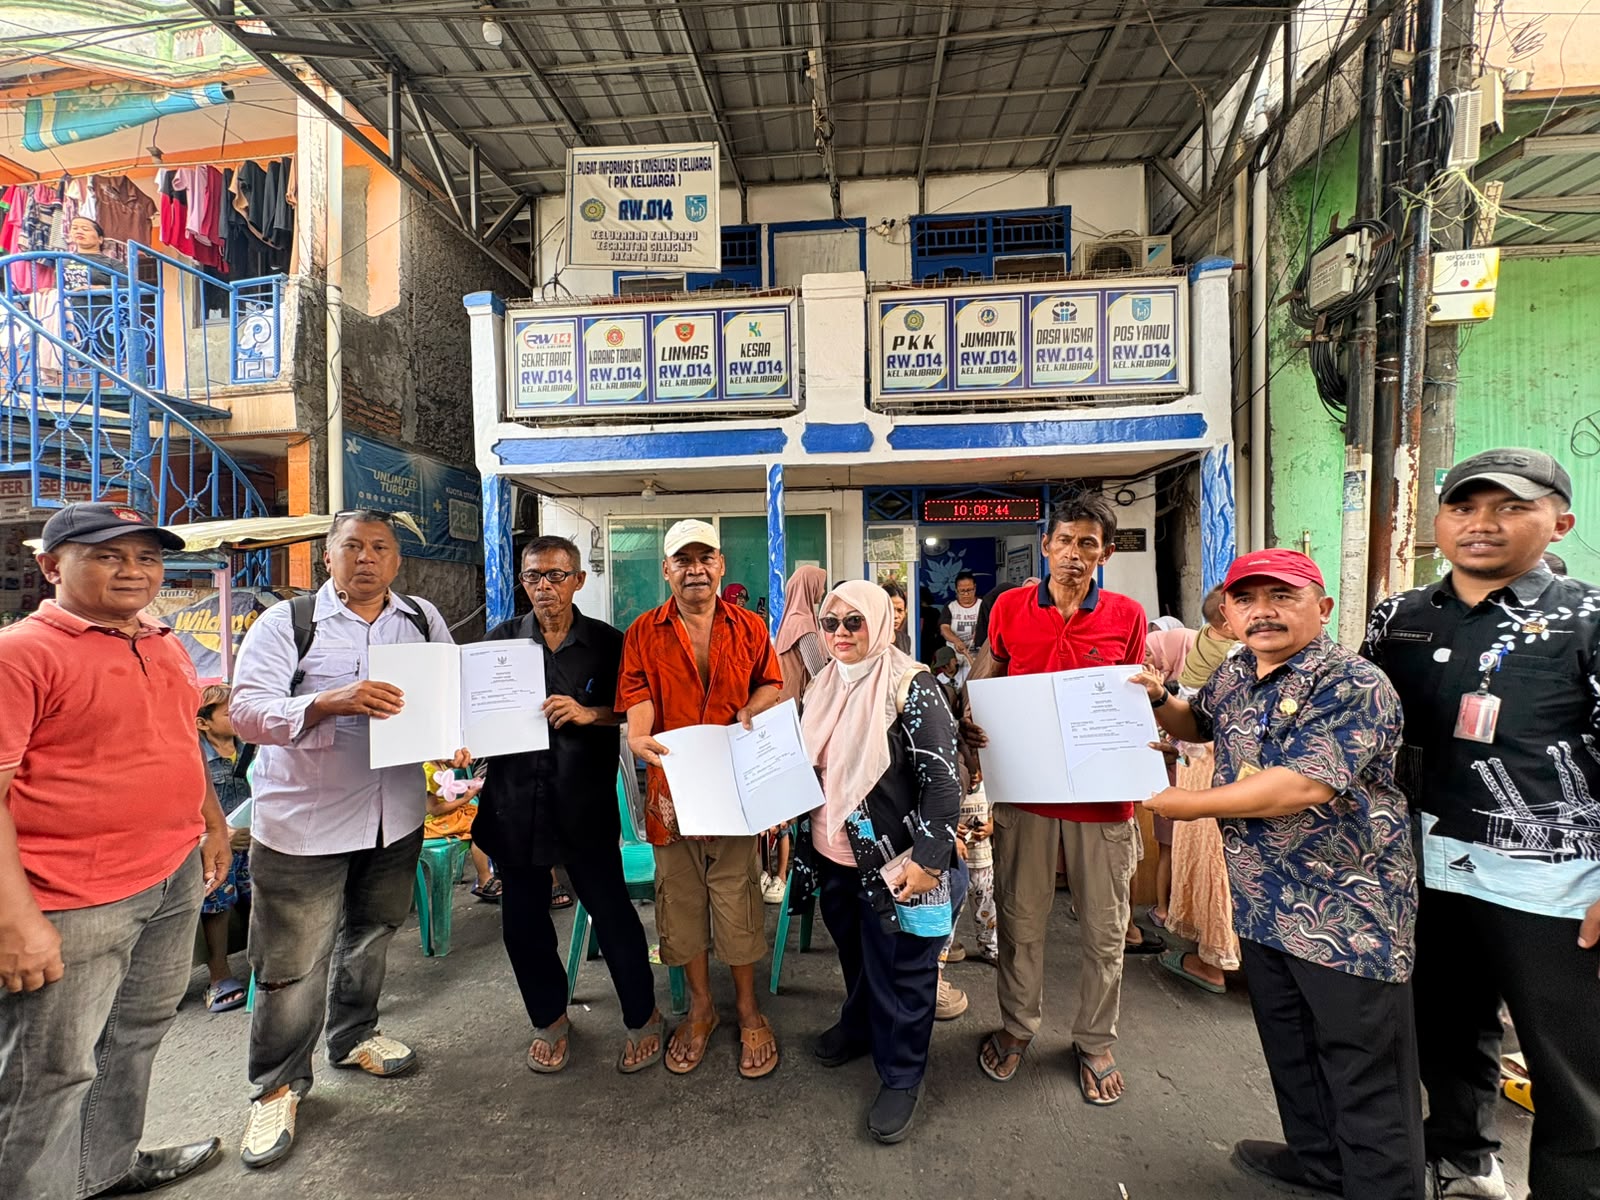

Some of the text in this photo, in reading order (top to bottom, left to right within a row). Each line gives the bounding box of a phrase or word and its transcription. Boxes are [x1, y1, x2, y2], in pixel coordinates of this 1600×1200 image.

[577, 156, 712, 175] PUSAT INFORMASI & KONSULTASI KELUARGA
[614, 175, 628, 188] PIK
[631, 174, 676, 188] KELUARGA
[618, 198, 674, 221] RW.014
[591, 230, 699, 242] KELURAHAN KALIBARU
[596, 241, 648, 251] KECAMATAN
[610, 251, 679, 262] JAKARTA UTARA
[960, 330, 1017, 348] JUMANTIK
[1036, 326, 1094, 345] DASA WISMA
[1113, 324, 1170, 342] POS YANDU
[589, 348, 642, 365] KARANG TARUNA
[661, 345, 709, 361] LINMAS
[740, 342, 771, 358] KESRA
[1036, 346, 1094, 363] RW.014
[1113, 343, 1171, 360] RW.014
[521, 352, 572, 368] SEKRETARIAT
[887, 352, 942, 369] RW.014
[961, 350, 1017, 366] RW.014
[1130, 359, 1171, 368] KALIBARU
[590, 366, 642, 382] RW.014
[659, 363, 712, 379] RW.014
[729, 360, 783, 376] RW.014
[904, 368, 942, 377] KALIBARU
[978, 365, 1017, 374] KALIBARU
[1054, 362, 1093, 371] KALIBARU
[521, 370, 573, 385] RW.014
[675, 378, 712, 387] KALIBARU
[746, 375, 783, 384] KALIBARU
[537, 384, 573, 393] KALIBARU
[606, 381, 642, 390] KALIBARU
[0, 480, 23, 494] FER
[373, 469, 418, 490] UNLIMITED
[381, 482, 410, 497] TURBO
[954, 504, 1009, 516] 10:09:44
[961, 804, 983, 814] smile
